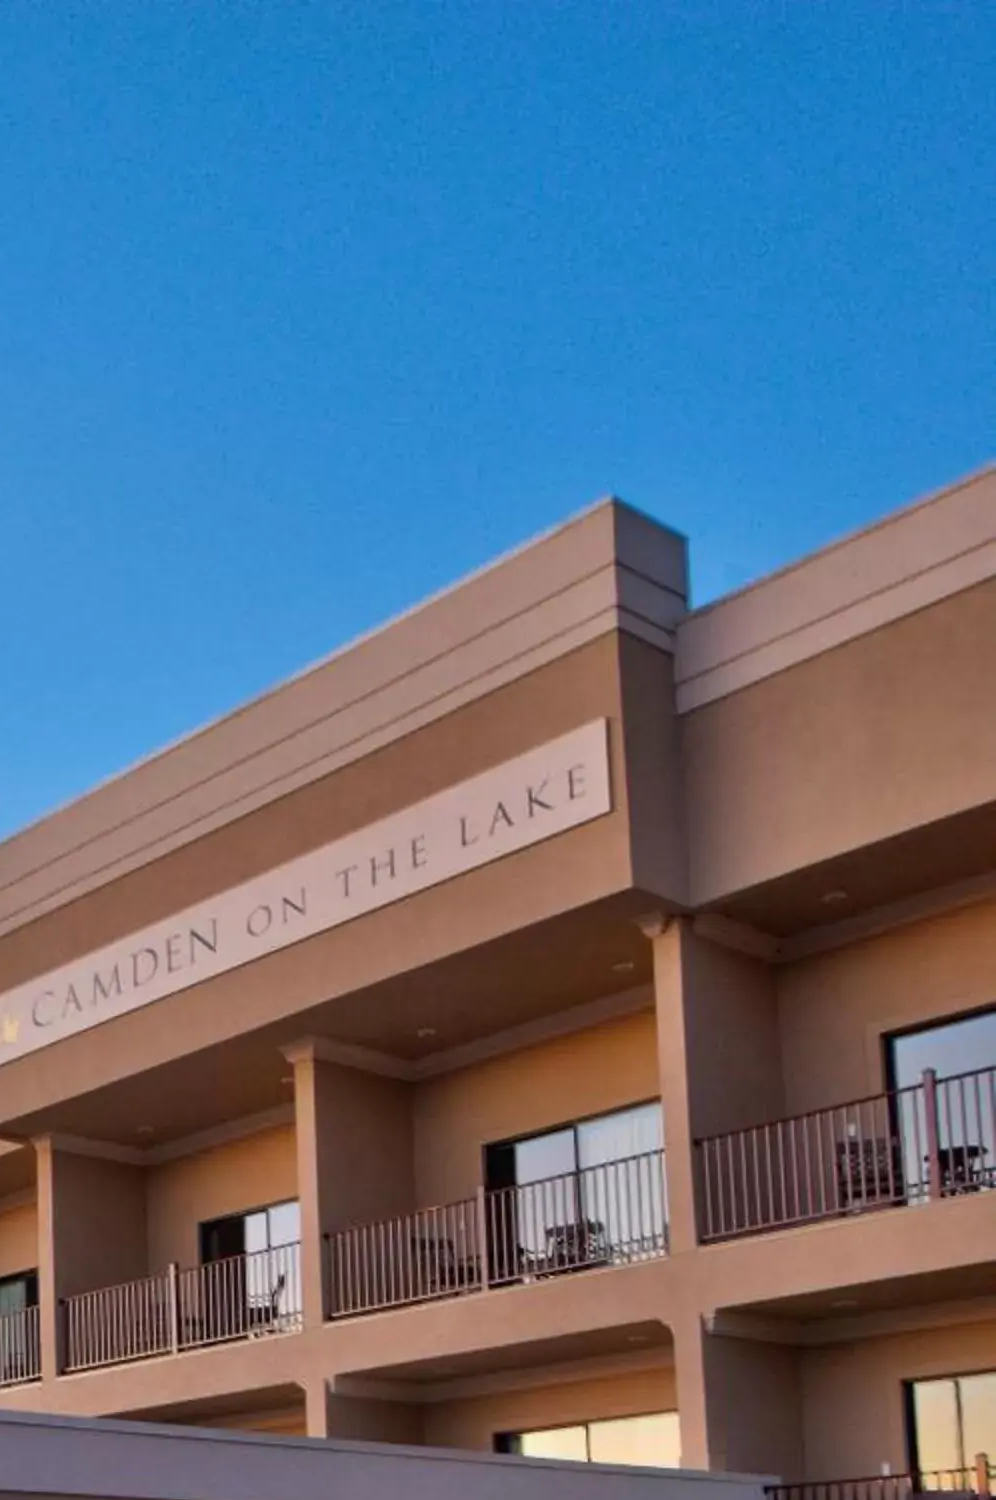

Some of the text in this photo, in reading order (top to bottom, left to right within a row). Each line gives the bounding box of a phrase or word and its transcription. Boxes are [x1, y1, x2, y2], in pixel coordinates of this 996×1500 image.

[31, 762, 588, 1028] CAMDEN ON THE LAKE
